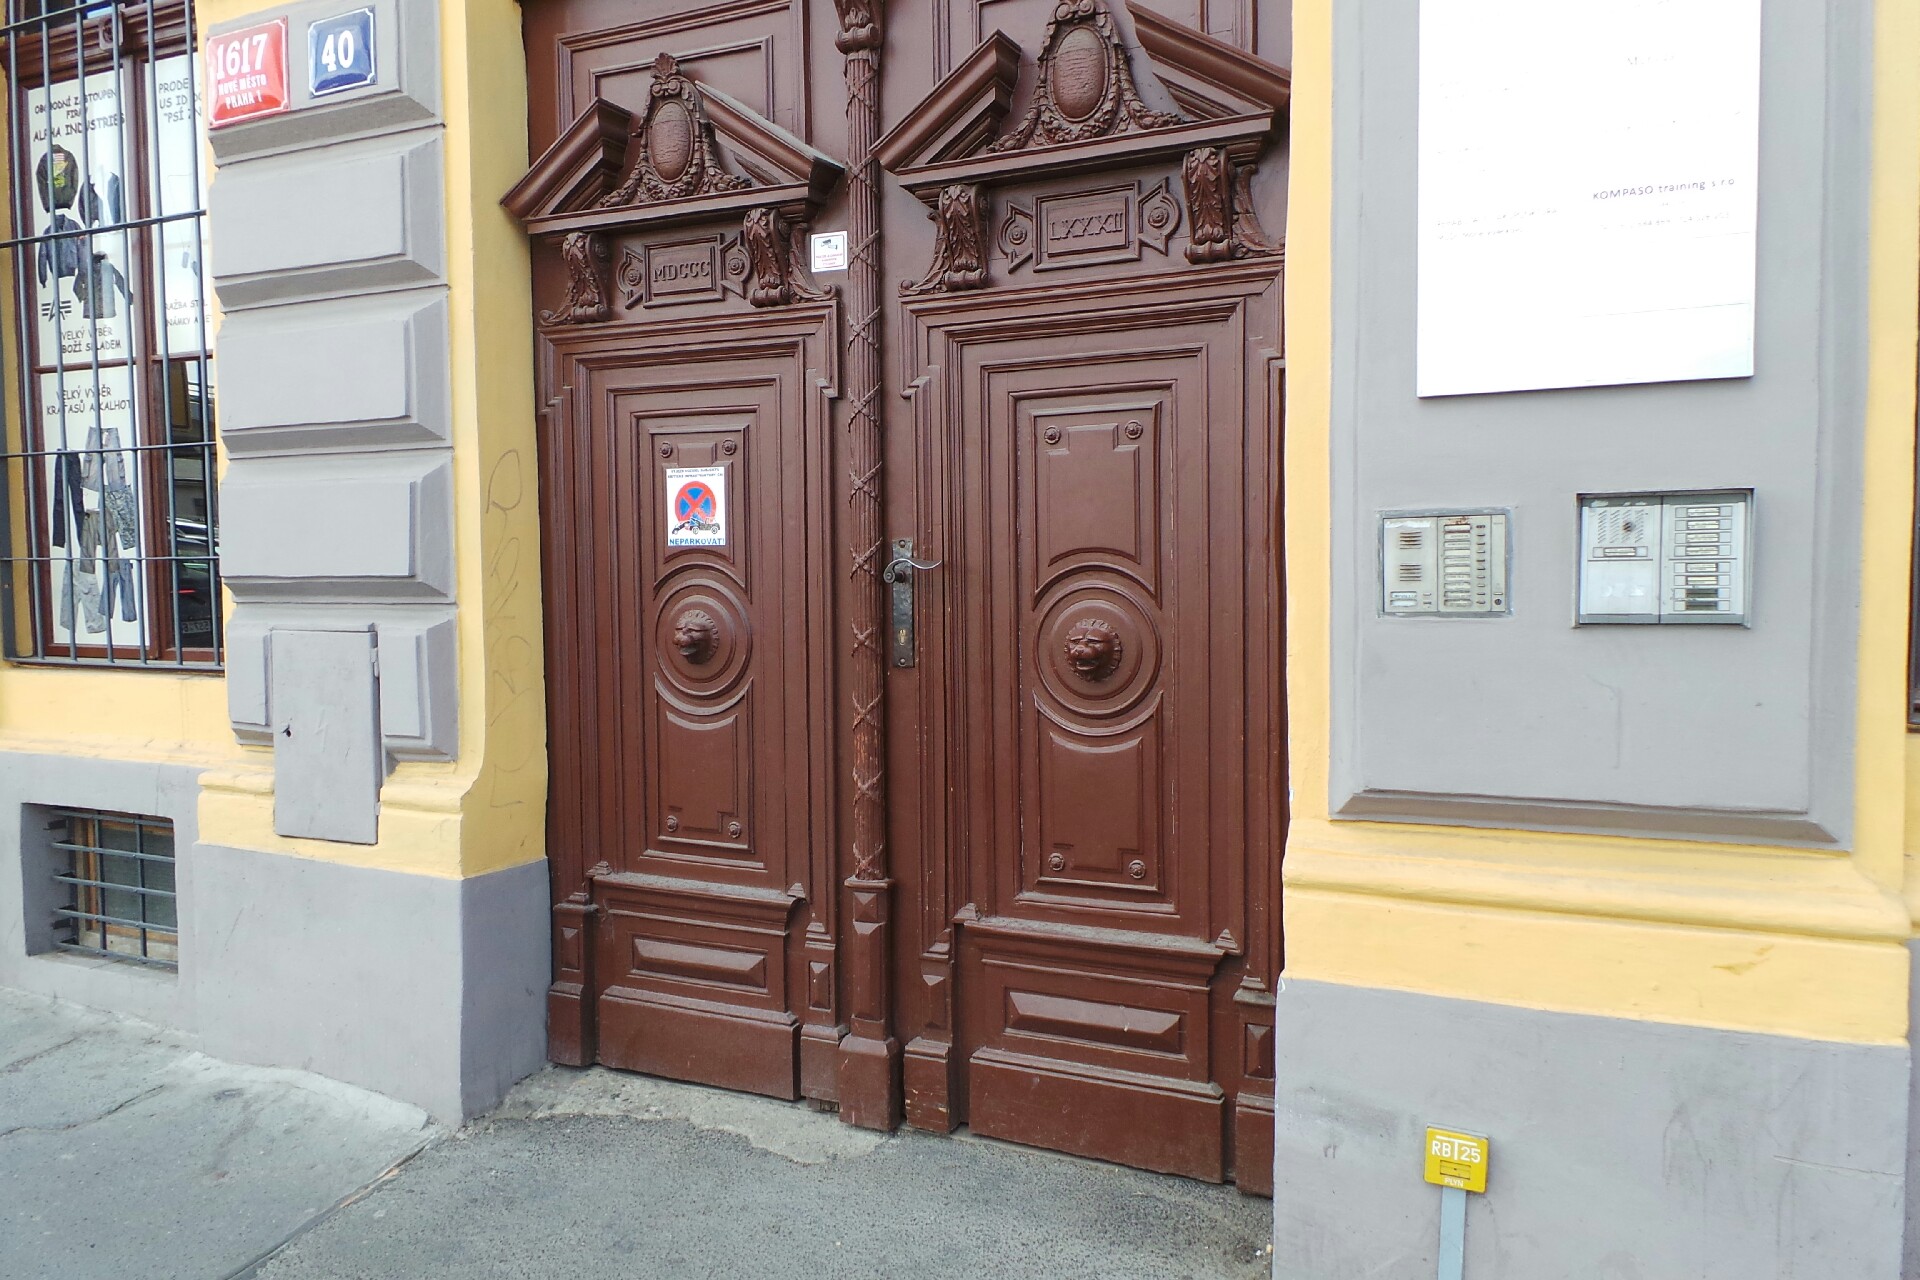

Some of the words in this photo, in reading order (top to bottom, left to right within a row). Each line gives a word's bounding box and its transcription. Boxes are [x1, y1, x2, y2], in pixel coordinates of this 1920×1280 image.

[216, 33, 268, 80] 1617
[321, 30, 354, 72] 40
[159, 77, 191, 93] PRODE
[218, 76, 239, 96] NOVÉ
[240, 73, 267, 91] MĚSTO
[35, 95, 72, 114] OBODNÍ
[74, 89, 118, 105] ZSTOUPEN
[160, 98, 172, 109] US
[176, 95, 188, 106] ID
[225, 94, 254, 109] PRAHA
[256, 91, 262, 103] 1
[66, 107, 88, 119] FIR
[1593, 185, 1654, 200] KOMPASO
[1658, 180, 1706, 193] training
[653, 261, 712, 283] MDCCC
[61, 326, 86, 340] VELKÝ
[88, 325, 113, 339] VBĚR
[61, 340, 82, 353] BOŽÍ
[85, 340, 121, 352] SLADEM
[85, 384, 112, 398] VÝĚR
[1431, 1140, 1452, 1158] RB
[1460, 1146, 1481, 1163] 25
[1444, 1177, 1464, 1187] PLYN
